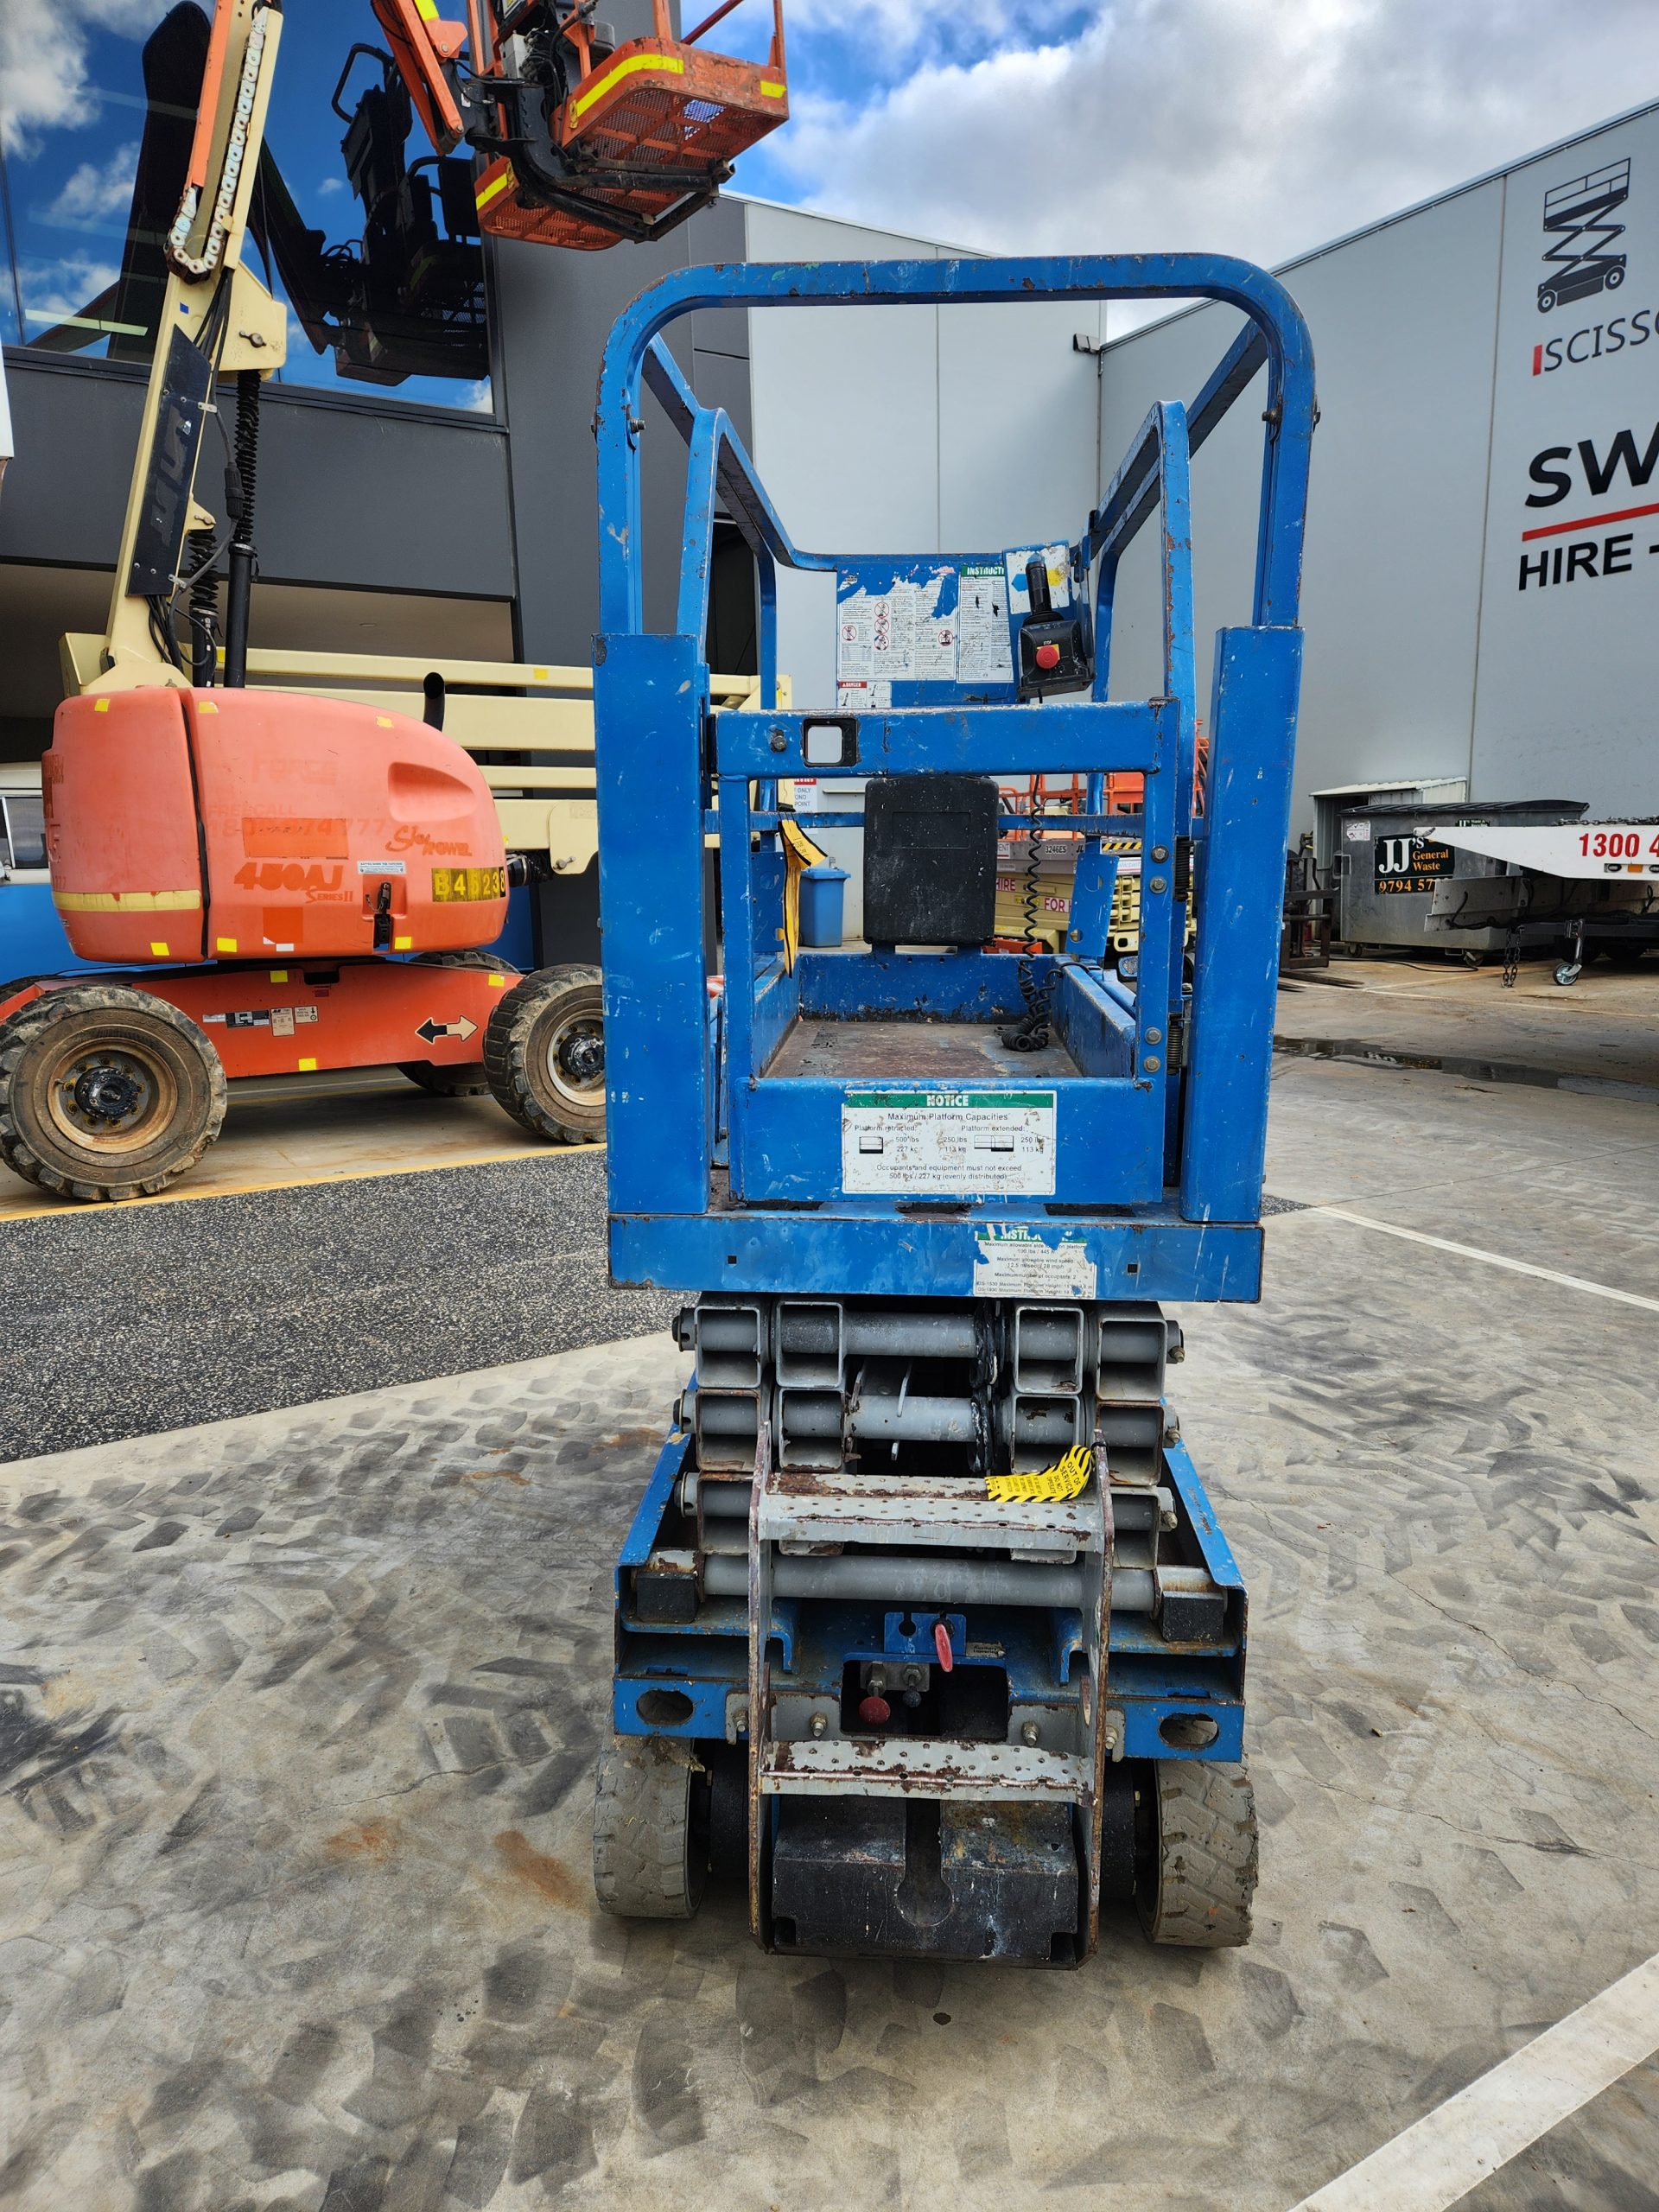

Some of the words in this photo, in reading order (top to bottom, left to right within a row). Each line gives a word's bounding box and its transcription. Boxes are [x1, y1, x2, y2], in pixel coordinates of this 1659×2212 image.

[1544, 308, 1659, 372] SCISS
[1518, 532, 1633, 591] HIRE
[1045, 845, 1067, 854] 3246ES
[1579, 833, 1640, 857] 1300
[1412, 849, 1449, 860] General
[1413, 861, 1441, 872] Waste
[1379, 879, 1413, 893] 9794
[1044, 898, 1065, 912] FOR
[926, 1094, 969, 1107] NOTICE
[965, 1113, 1008, 1122] Capacities
[1060, 1466, 1073, 1493] SERVICE
[1067, 1461, 1077, 1477] OUT
[1073, 1477, 1081, 1486] OF
